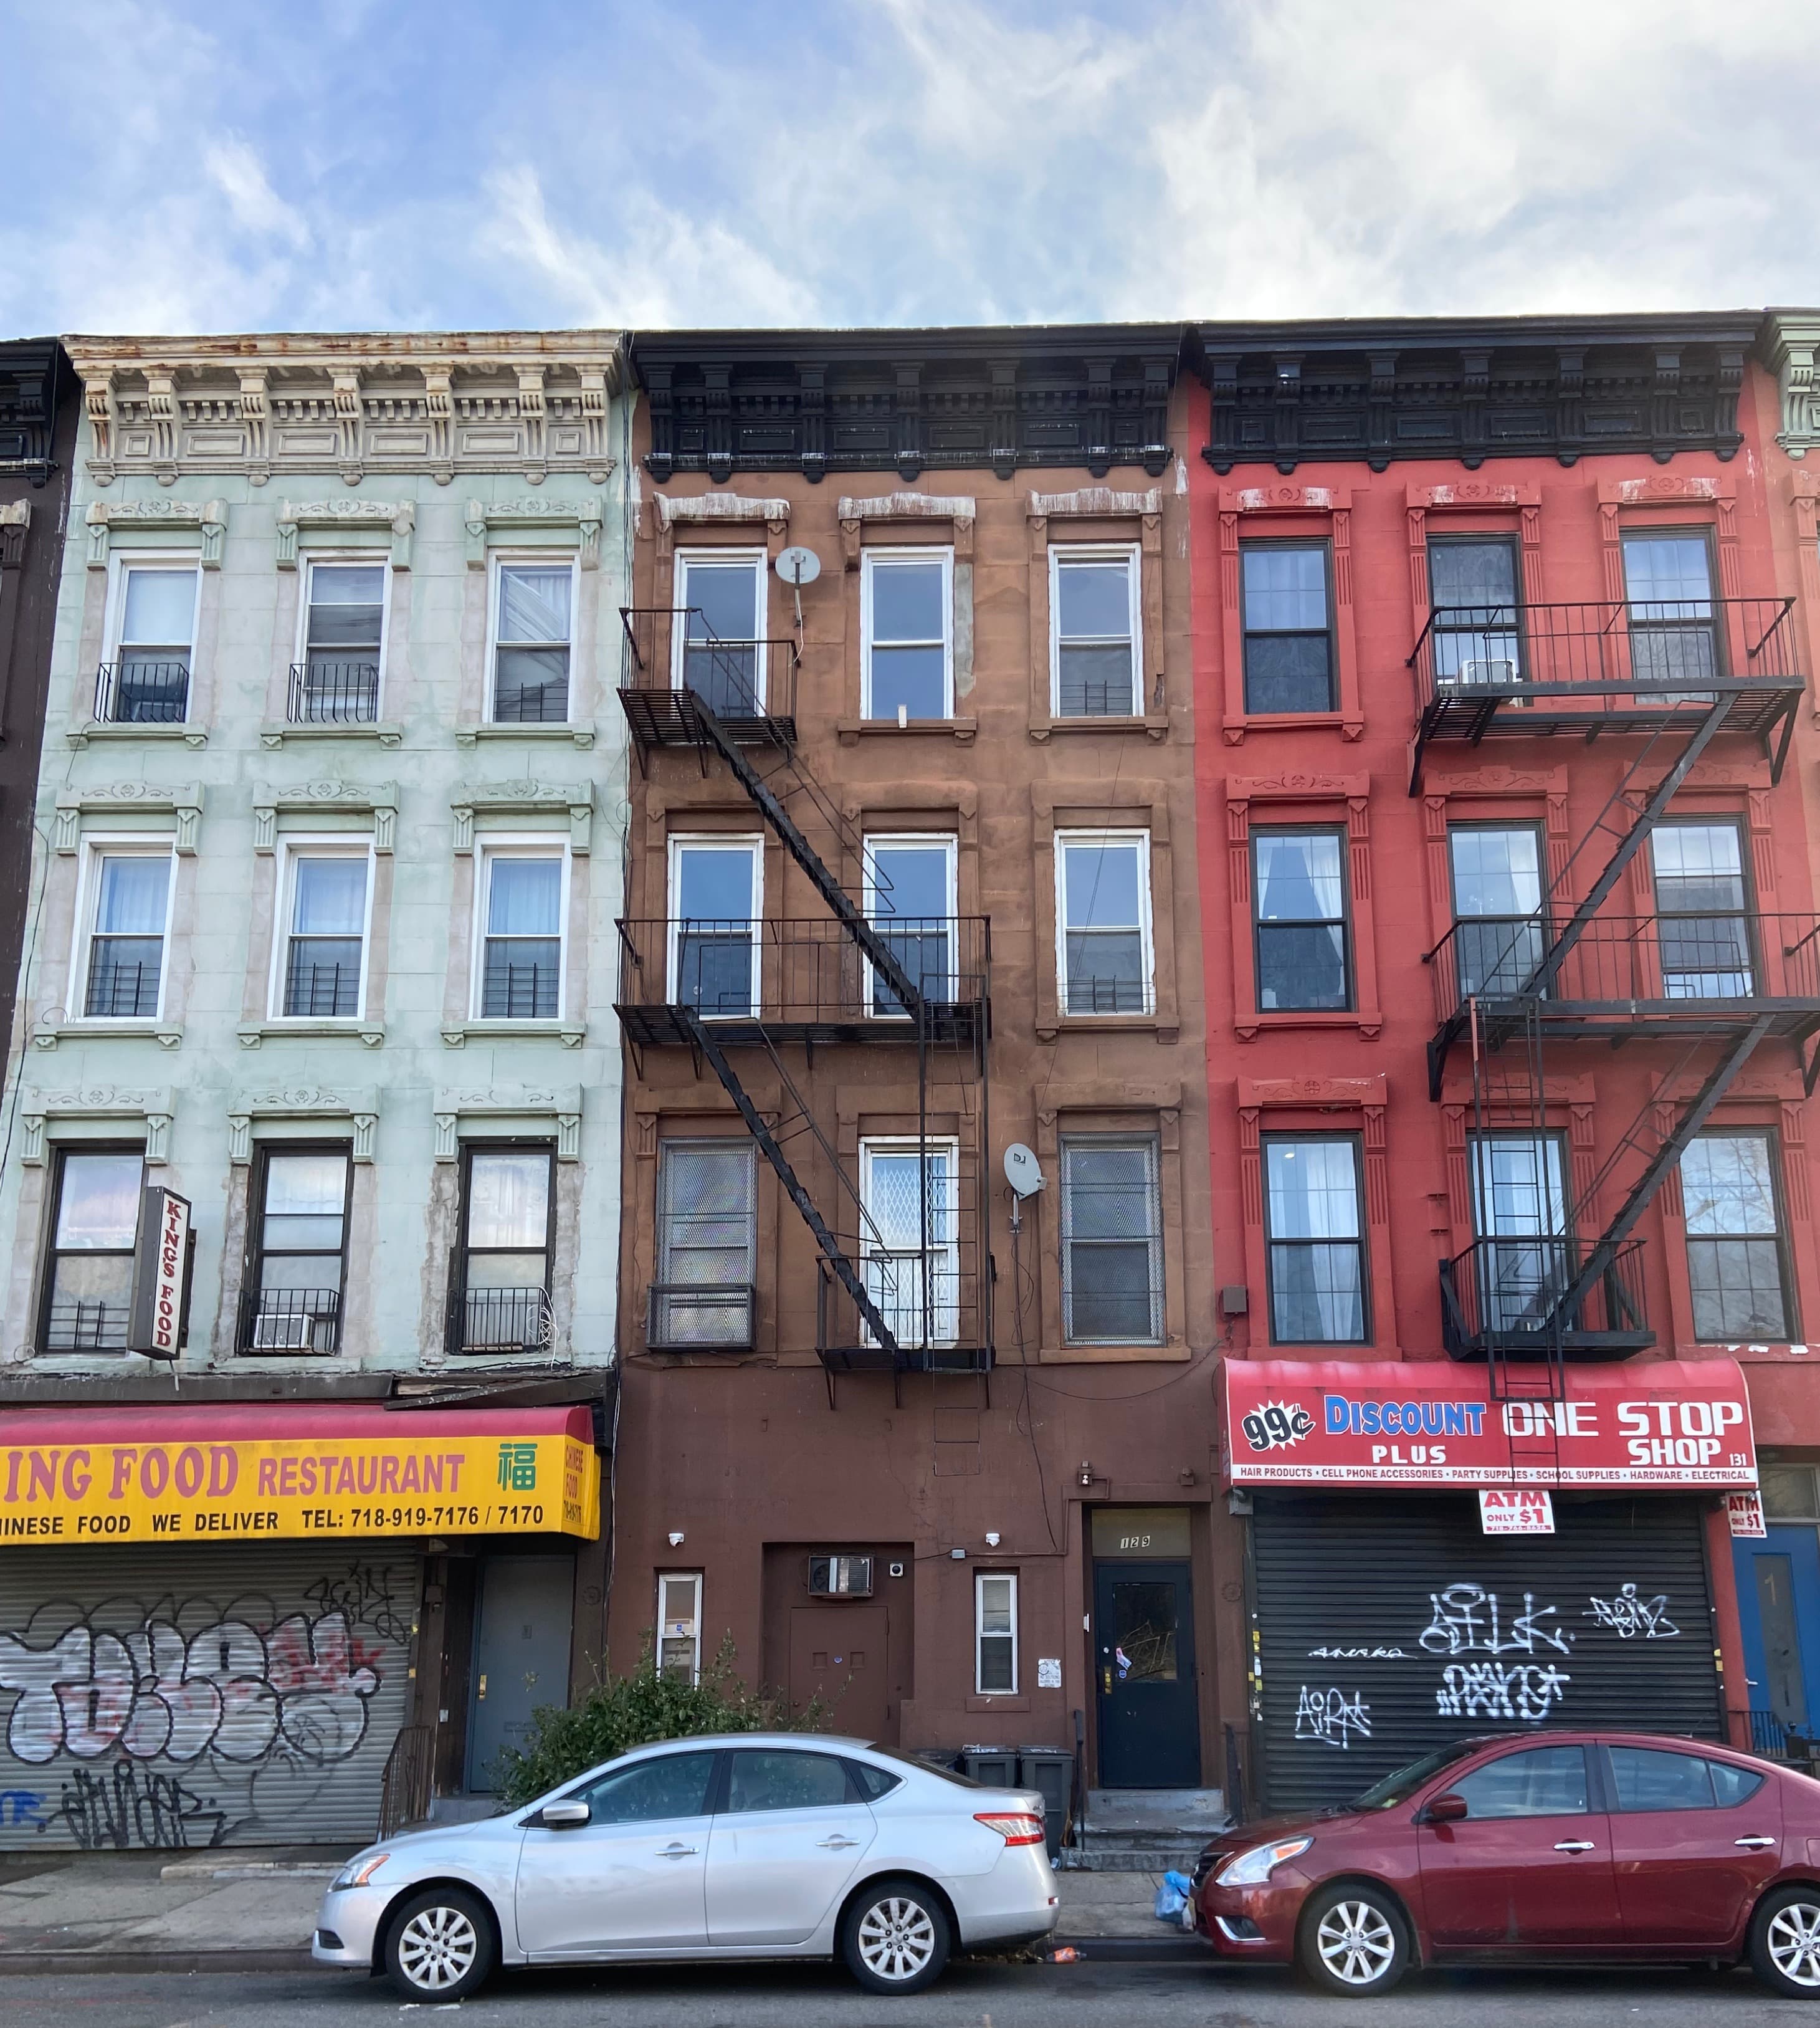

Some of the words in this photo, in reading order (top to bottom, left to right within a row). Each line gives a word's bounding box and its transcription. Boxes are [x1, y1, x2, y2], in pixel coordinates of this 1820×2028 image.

[156, 1283, 174, 1347] FOOD
[1324, 1395, 1487, 1436] DISCOUNT
[1502, 1402, 1599, 1437] ONE
[1618, 1401, 1743, 1436] STOP
[1372, 1445, 1446, 1465] PLUS
[1627, 1438, 1721, 1465] SHOP
[1729, 1453, 1746, 1466] 131
[108, 1446, 239, 1499] FOOD
[258, 1454, 465, 1496] RESTAURANT
[497, 1443, 538, 1491] 福
[1241, 1467, 1262, 1476] HAIR
[1264, 1468, 1312, 1477] PRODUCTS
[1322, 1469, 1344, 1478] CELL
[1346, 1469, 1378, 1478] PHONE
[1380, 1470, 1443, 1479] ACCESSORIES
[1452, 1470, 1482, 1479] PARTY
[1484, 1470, 1528, 1479] SUPPLIES
[1536, 1470, 1574, 1480] SCHOOL
[1576, 1470, 1620, 1480] SUPPLIES
[1630, 1470, 1682, 1480] HARDWARE
[1692, 1471, 1750, 1480] ELECTRICAL
[1484, 1491, 1546, 1507] ATM
[1729, 1496, 1760, 1511] ATM
[78, 1516, 130, 1534] FOOD
[152, 1514, 181, 1531] WE
[195, 1512, 279, 1531] DELIVER
[302, 1509, 343, 1528] TEL:
[351, 1506, 479, 1527] 718-919-7176
[498, 1505, 543, 1524] 7170
[1520, 1509, 1544, 1524] $1
[1747, 1513, 1760, 1528] $1
[1122, 1536, 1150, 1548] 129
